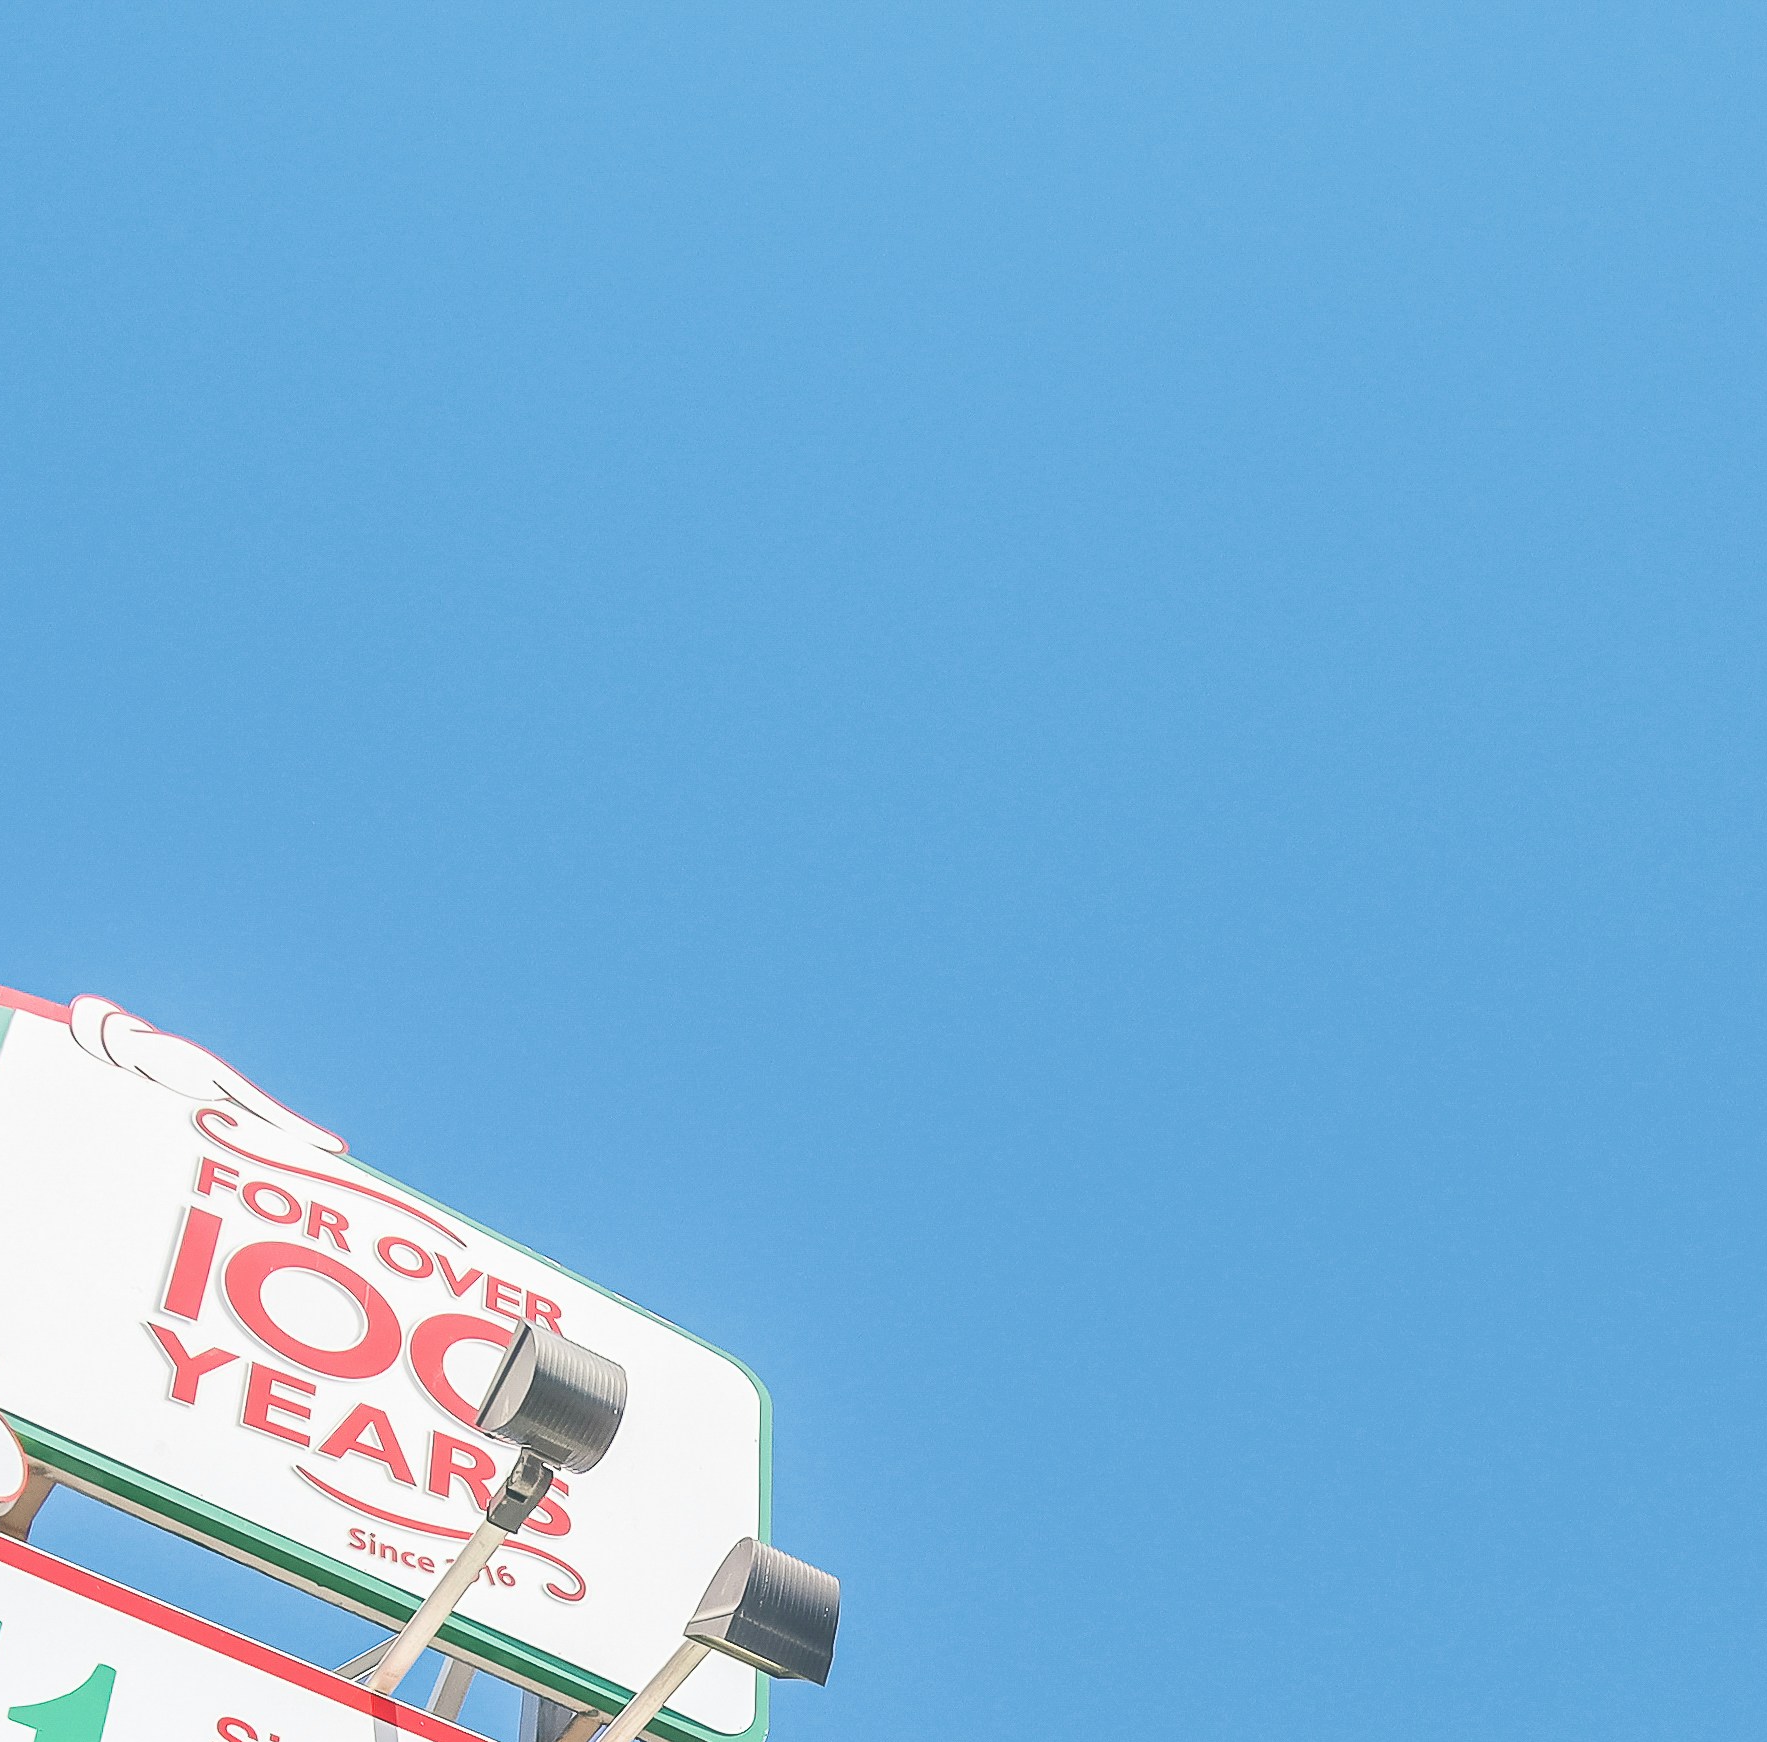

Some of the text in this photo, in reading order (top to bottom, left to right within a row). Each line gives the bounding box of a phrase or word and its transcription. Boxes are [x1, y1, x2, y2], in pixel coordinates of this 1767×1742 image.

[198, 1156, 564, 1338] FOR OVER
[347, 1527, 517, 1588] Since 16
